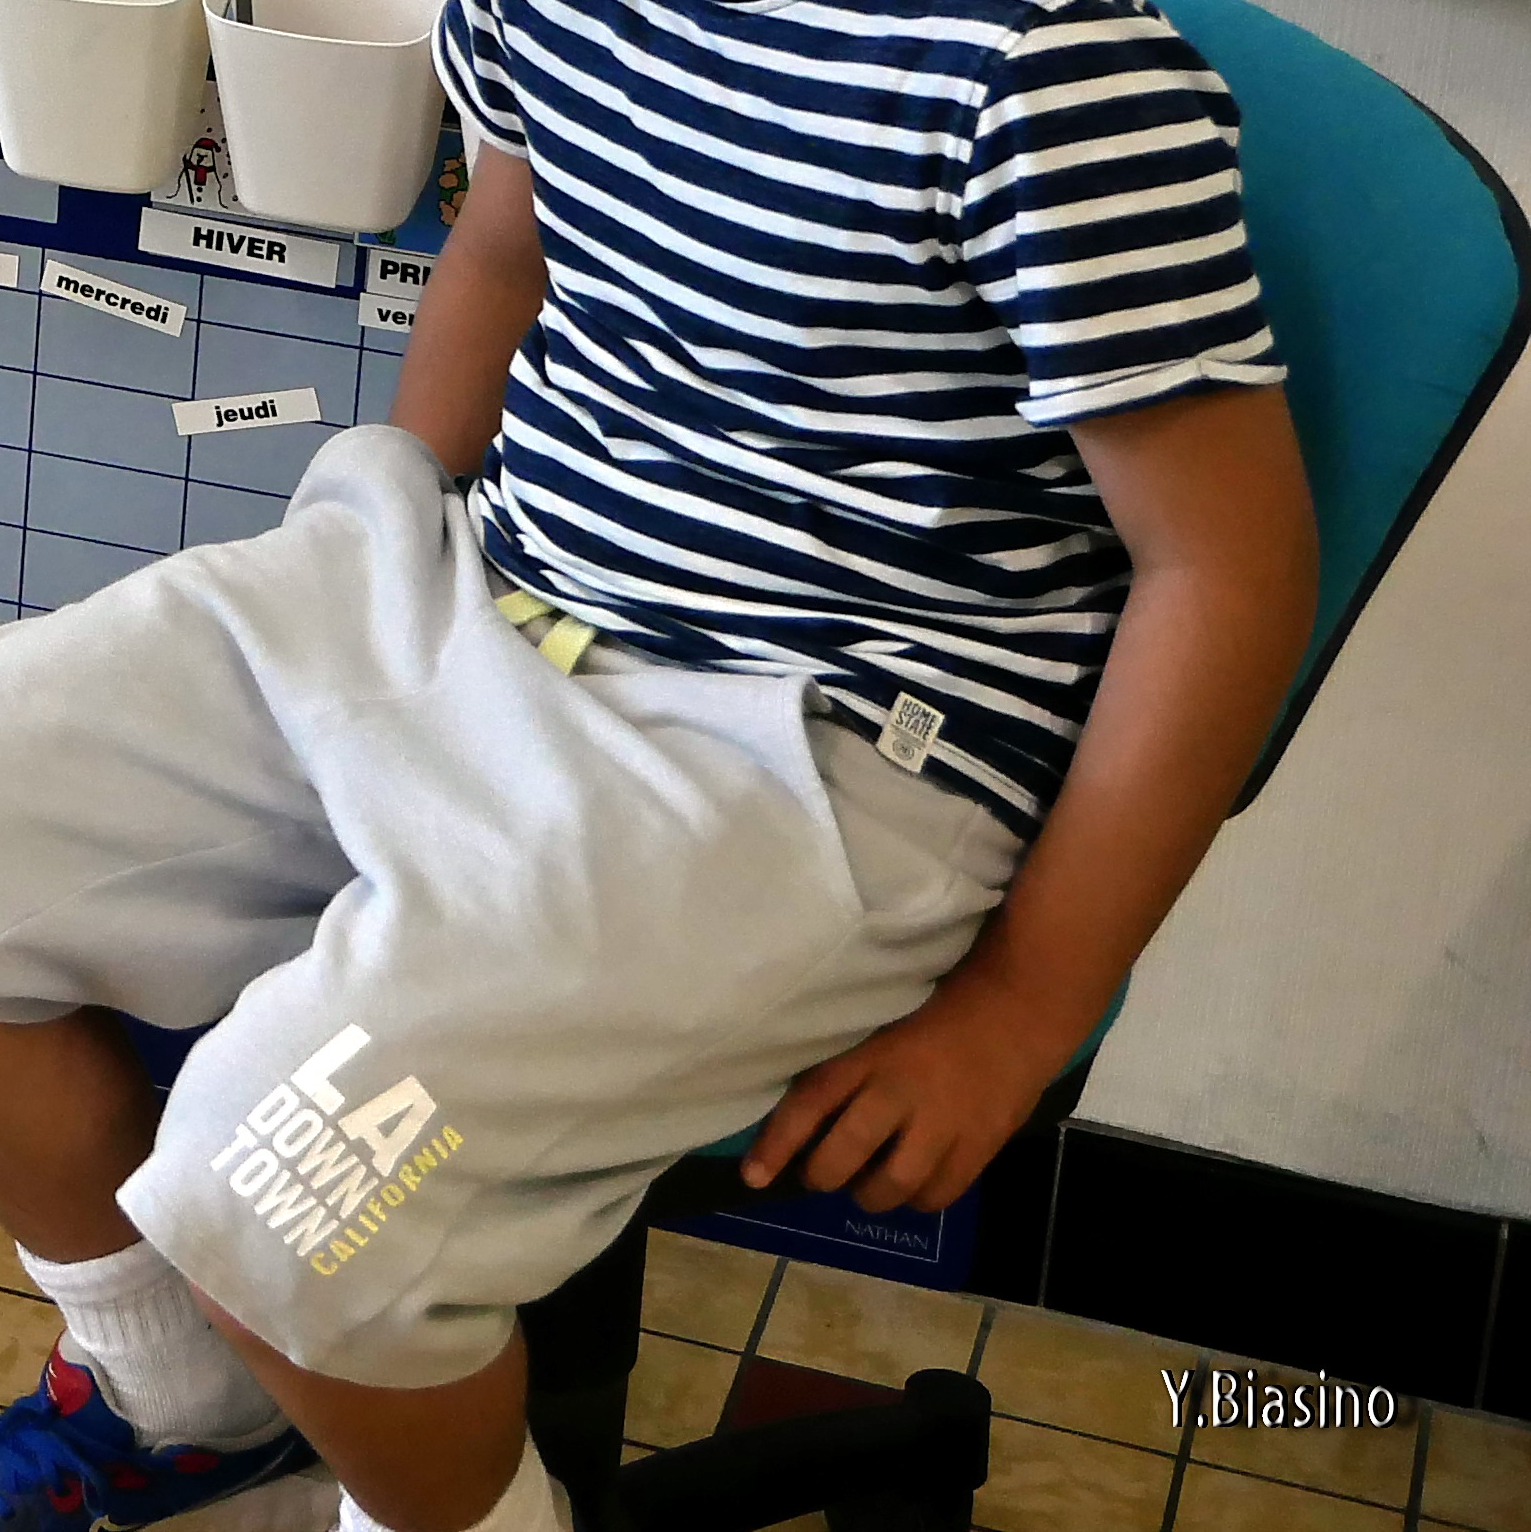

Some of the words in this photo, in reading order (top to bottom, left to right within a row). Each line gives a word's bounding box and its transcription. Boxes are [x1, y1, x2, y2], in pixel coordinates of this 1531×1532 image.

[192, 226, 287, 264] HIVER
[55, 271, 171, 326] mercredi
[214, 398, 279, 428] jeudi
[290, 1022, 437, 1177] LA
[209, 1123, 340, 1258] TOWN
[246, 1082, 379, 1219] DOWN
[310, 1125, 464, 1276] CALIFORNIA
[845, 1219, 929, 1250] NATHAN
